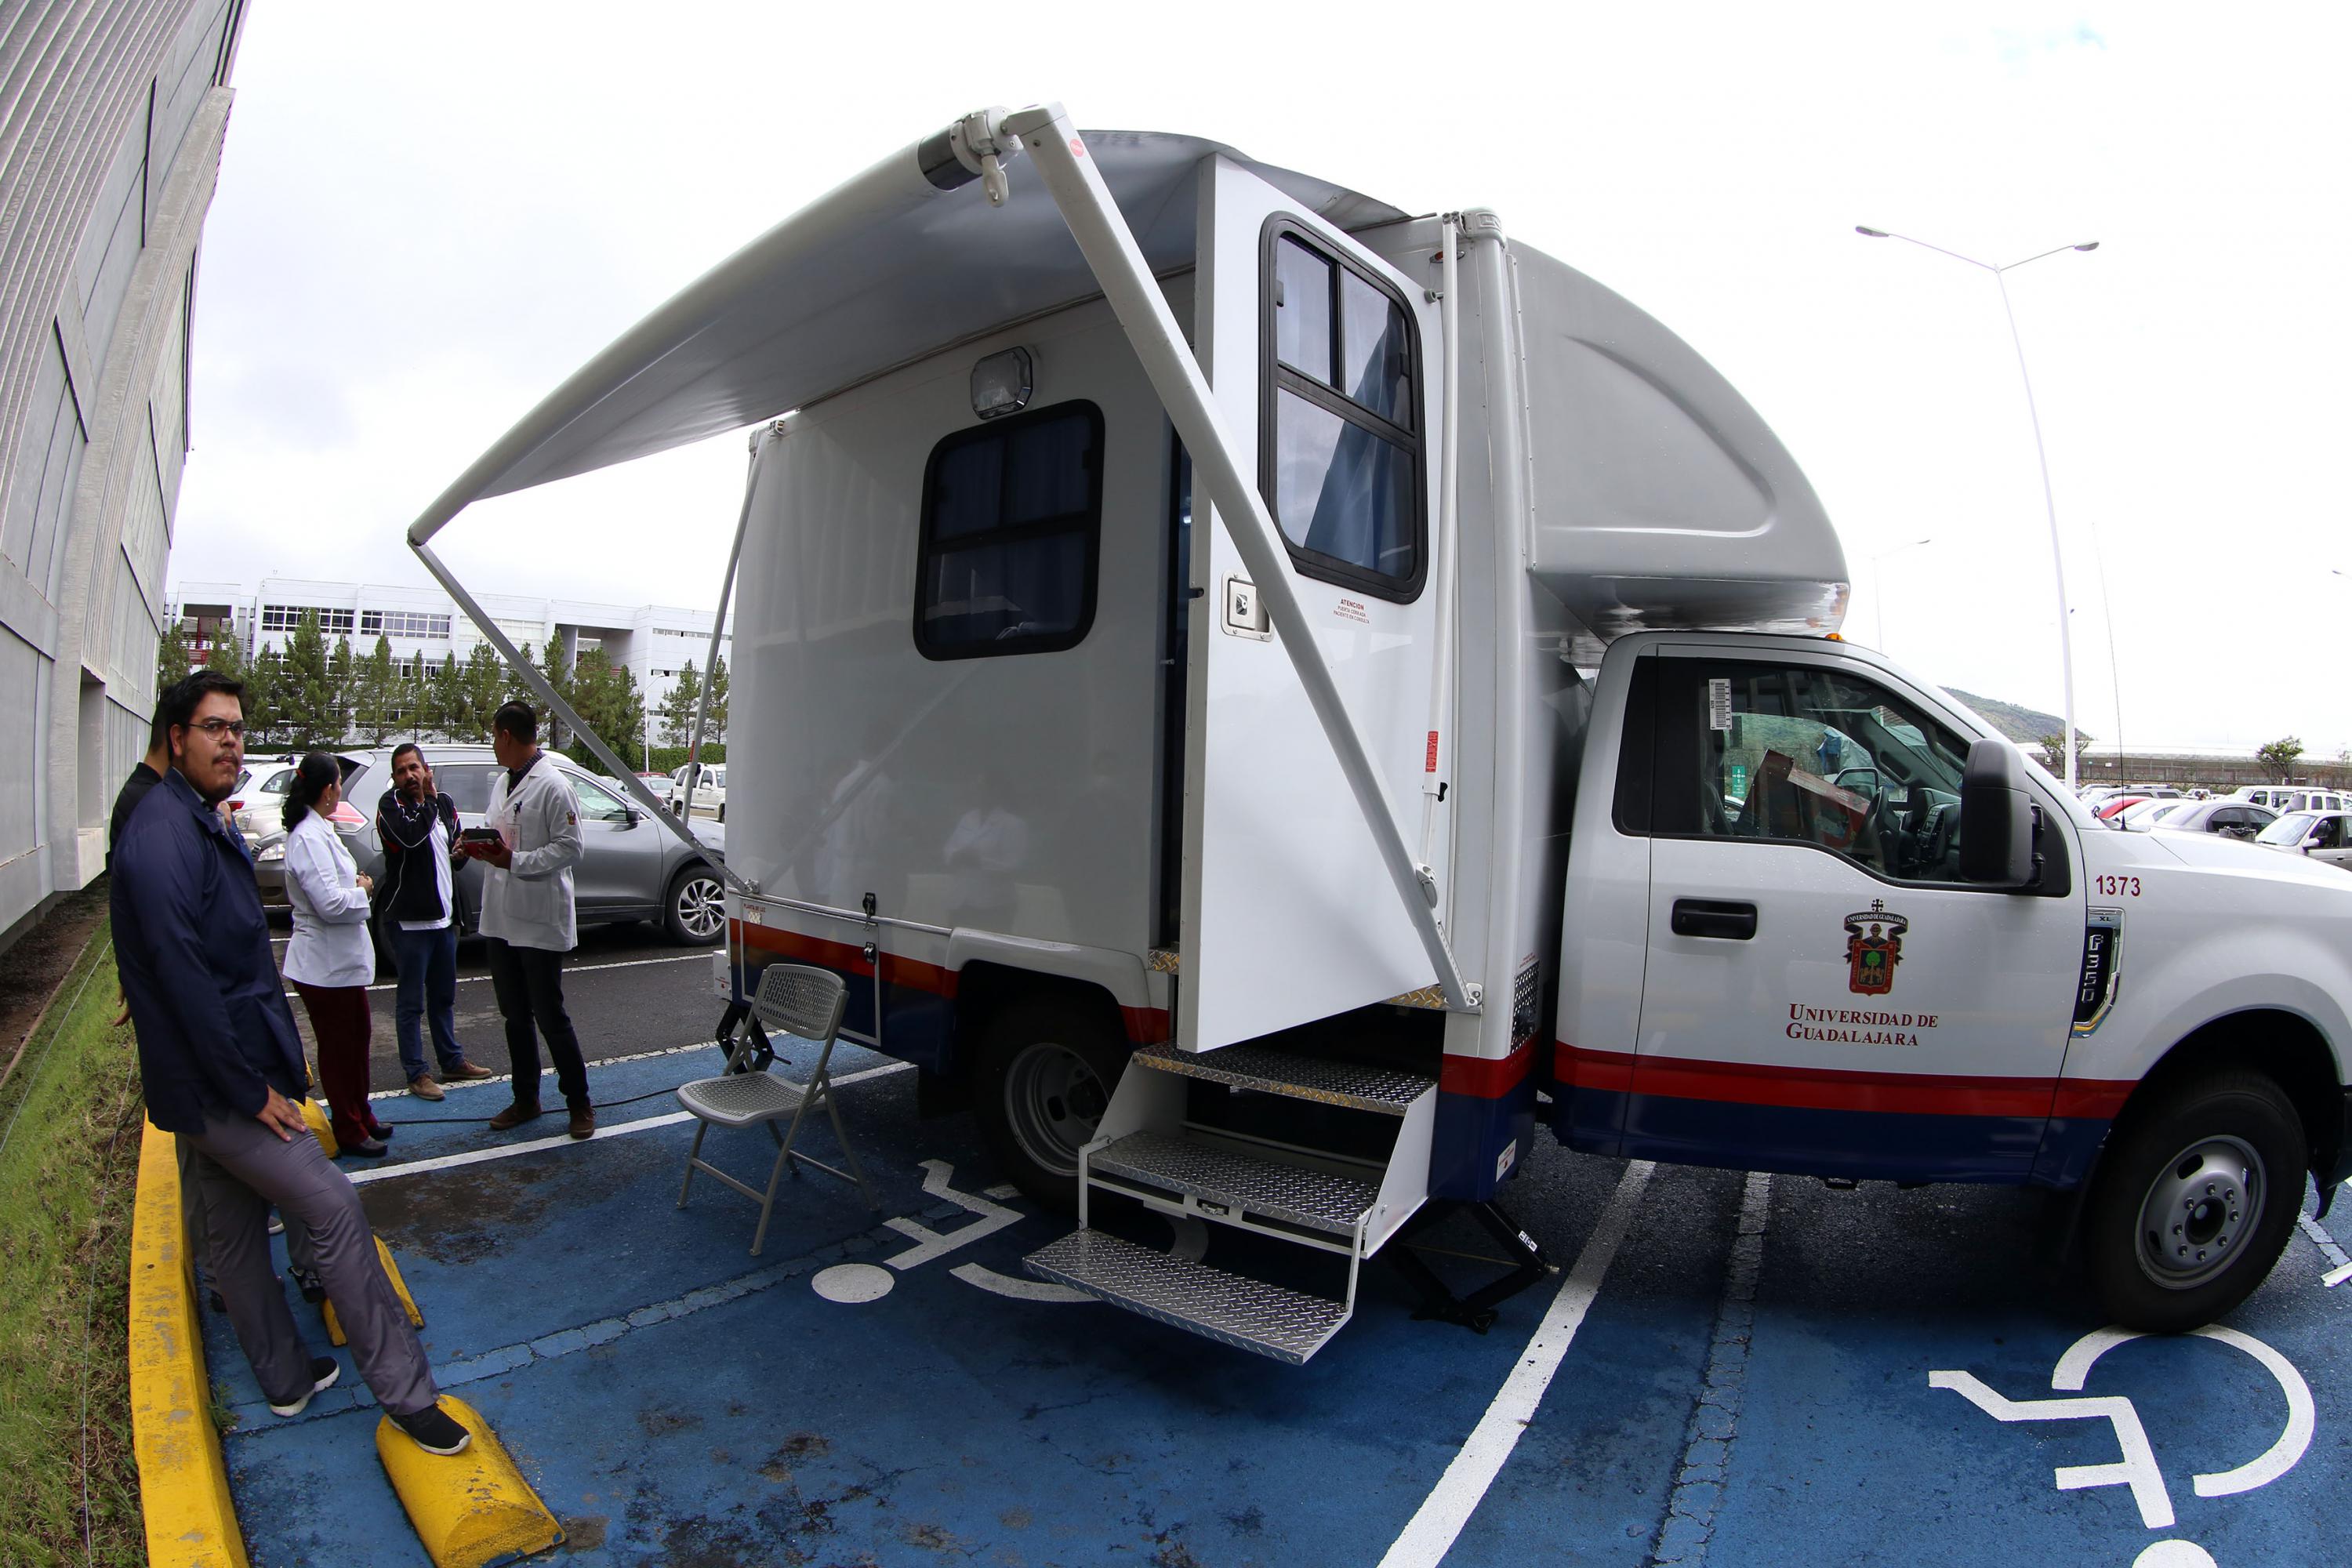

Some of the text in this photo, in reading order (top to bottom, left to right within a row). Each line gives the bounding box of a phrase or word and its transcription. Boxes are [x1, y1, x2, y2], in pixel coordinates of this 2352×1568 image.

[1341, 598, 1364, 610] ATENCION
[2096, 875, 2140, 897] 1373
[1847, 913, 1873, 923] UNIVERSIDAD
[1879, 914, 1907, 924] GUADALAJARA
[1789, 1003, 1938, 1028] UNIVERSIDAD DE
[1786, 1022, 1918, 1046] GUADALAJARA
